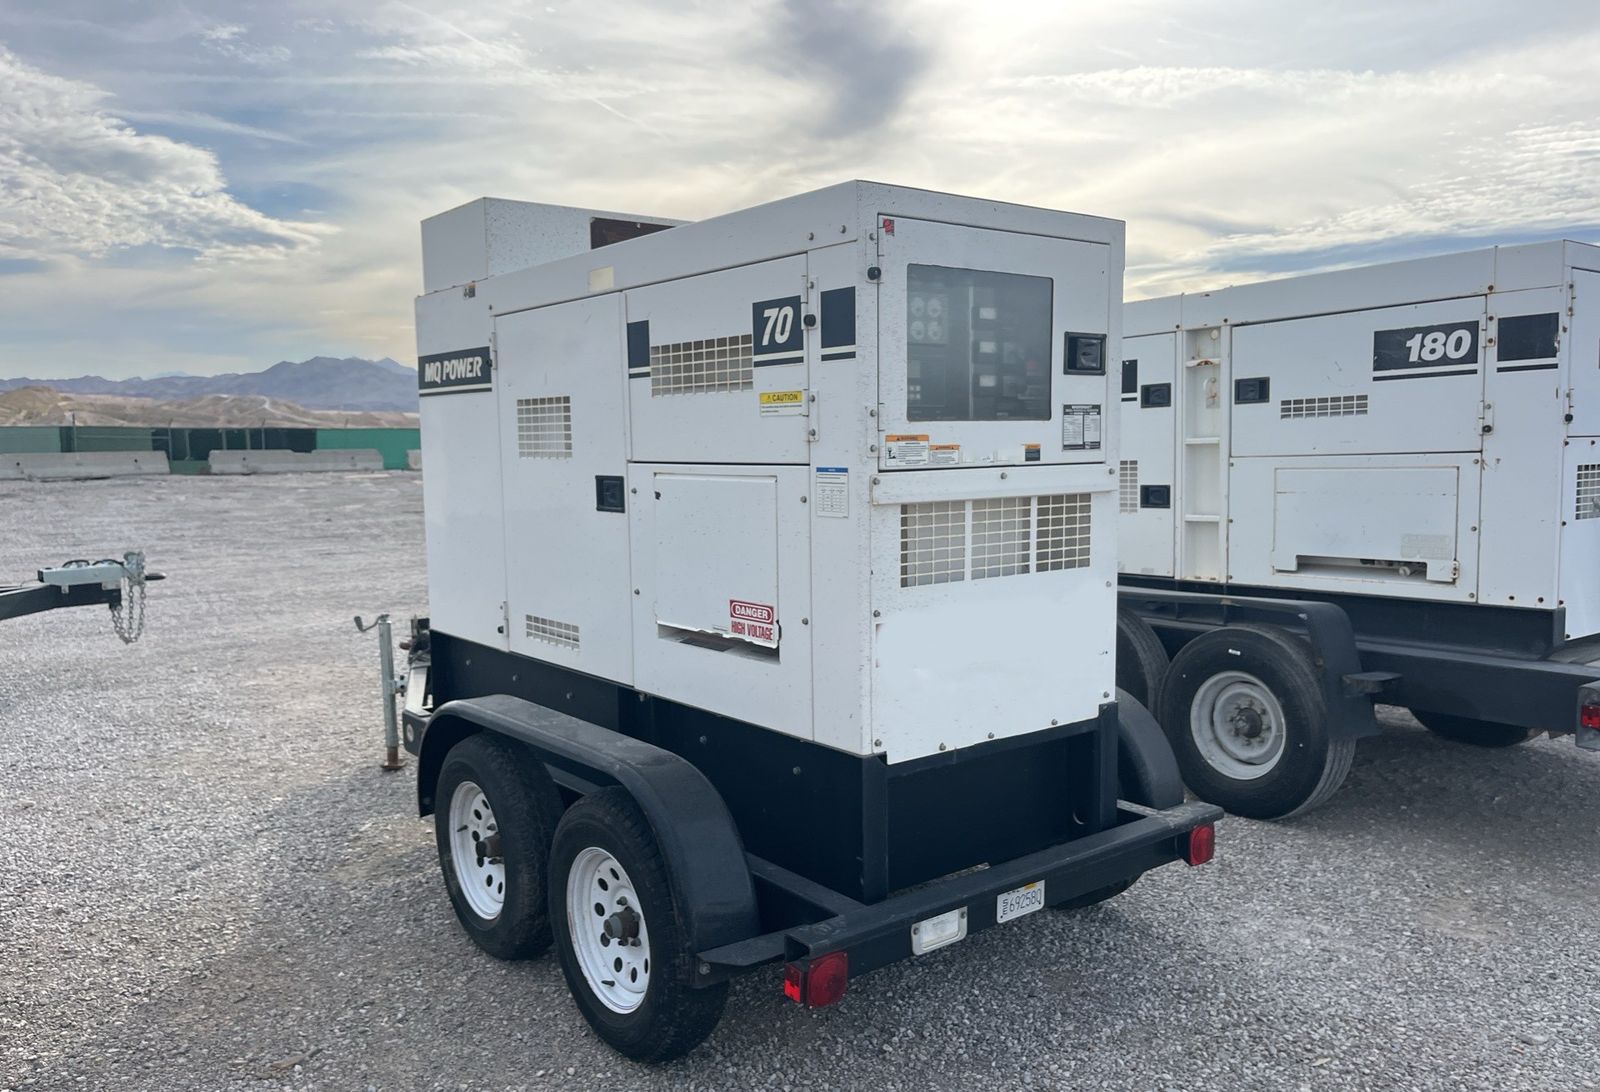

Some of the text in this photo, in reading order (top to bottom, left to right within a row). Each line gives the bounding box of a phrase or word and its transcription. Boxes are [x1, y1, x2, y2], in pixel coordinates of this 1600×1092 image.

[762, 305, 794, 346] 70
[1405, 328, 1472, 363] 180
[425, 356, 482, 384] MQ POWER
[771, 393, 798, 402] CAUTION
[735, 605, 768, 620] DANGER
[731, 620, 773, 640] HIGH VOLTAGE
